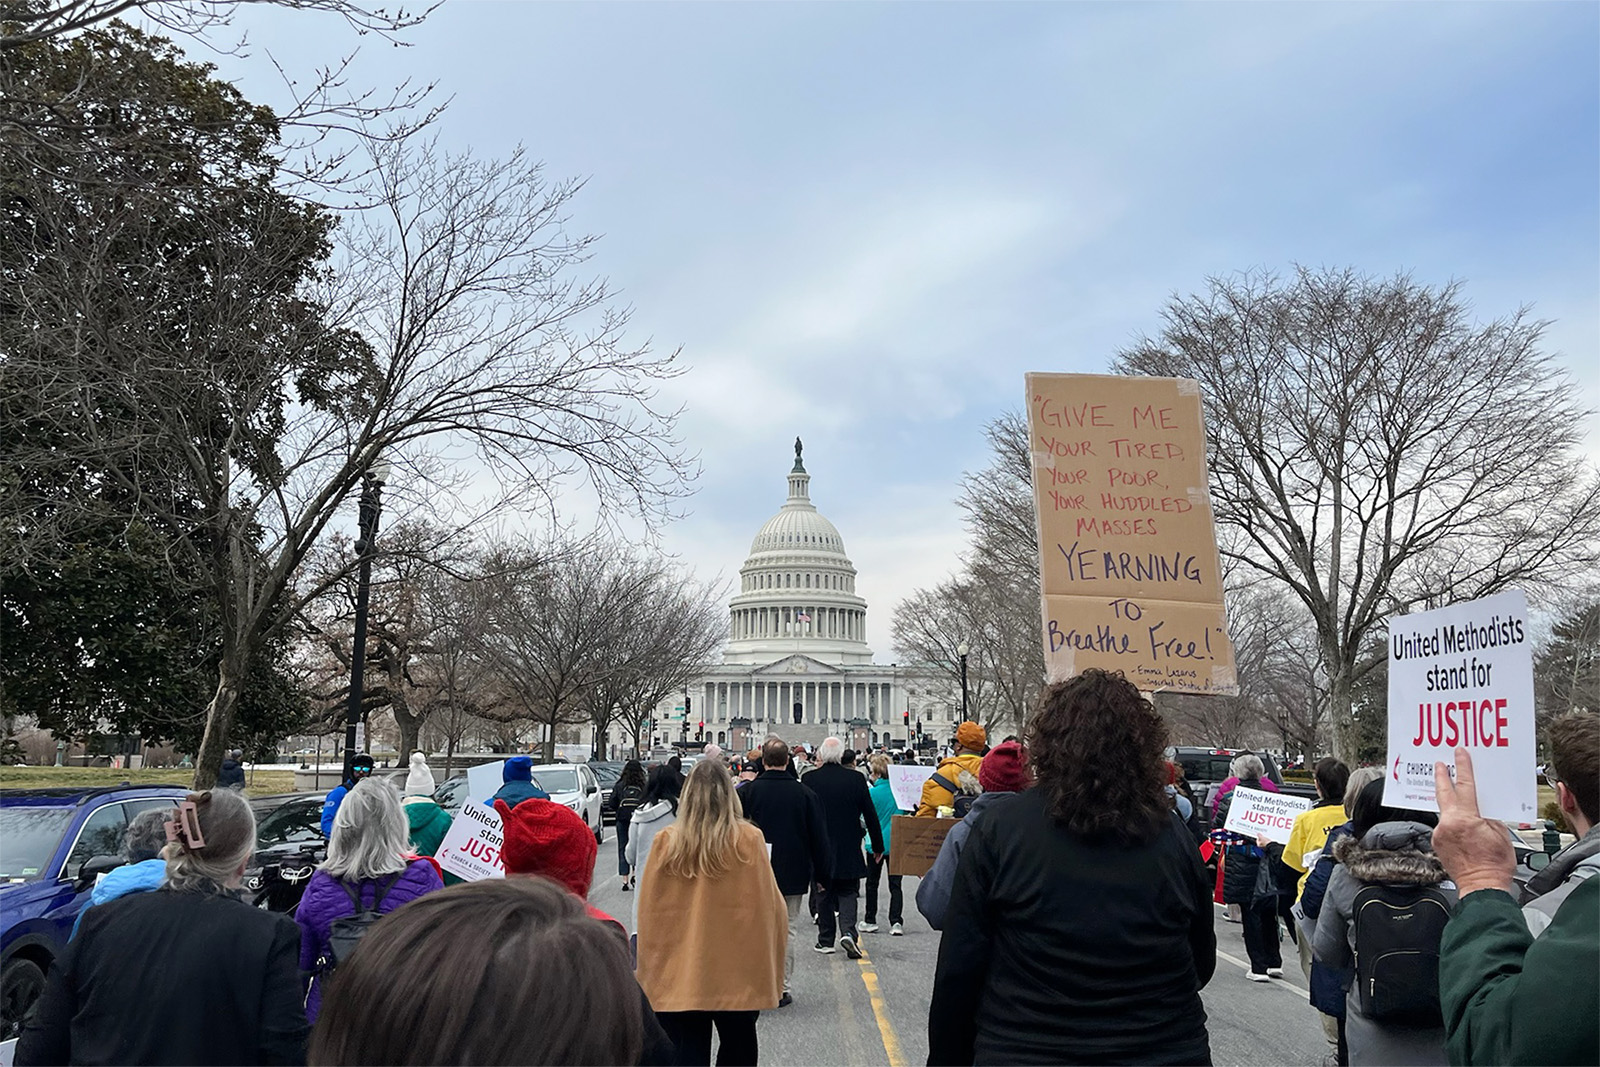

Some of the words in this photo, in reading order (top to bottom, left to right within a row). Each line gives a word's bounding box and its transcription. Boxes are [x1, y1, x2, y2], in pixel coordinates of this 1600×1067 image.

[1034, 395, 1114, 428] "GIVE
[1133, 405, 1178, 430] ME
[1041, 436, 1097, 460] YOUR
[1108, 439, 1185, 461] TIRED,
[1046, 467, 1090, 486] YOUR
[1108, 468, 1169, 490] POOR,
[1048, 491, 1091, 511] YOUR
[1100, 493, 1192, 513] HUDDLED
[1076, 517, 1157, 538] MASSES
[1058, 541, 1202, 584] YEARNING
[1108, 599, 1142, 621] TO
[1048, 620, 1138, 654] Breathe
[1149, 621, 1222, 660] Free!"
[1393, 628, 1440, 660] United
[1443, 615, 1525, 654] Methodists
[1427, 659, 1468, 691] stand
[1471, 657, 1492, 687] for
[1413, 699, 1509, 747] JUSTICE
[1406, 762, 1434, 776] CHURCH
[1236, 790, 1263, 803] United
[1264, 796, 1307, 810] Methodists
[1252, 803, 1275, 814] stand
[1275, 807, 1288, 815] for
[463, 804, 500, 829] United
[1241, 810, 1293, 830] JUSTICE
[479, 829, 504, 846] stan
[460, 837, 504, 870] JUST
